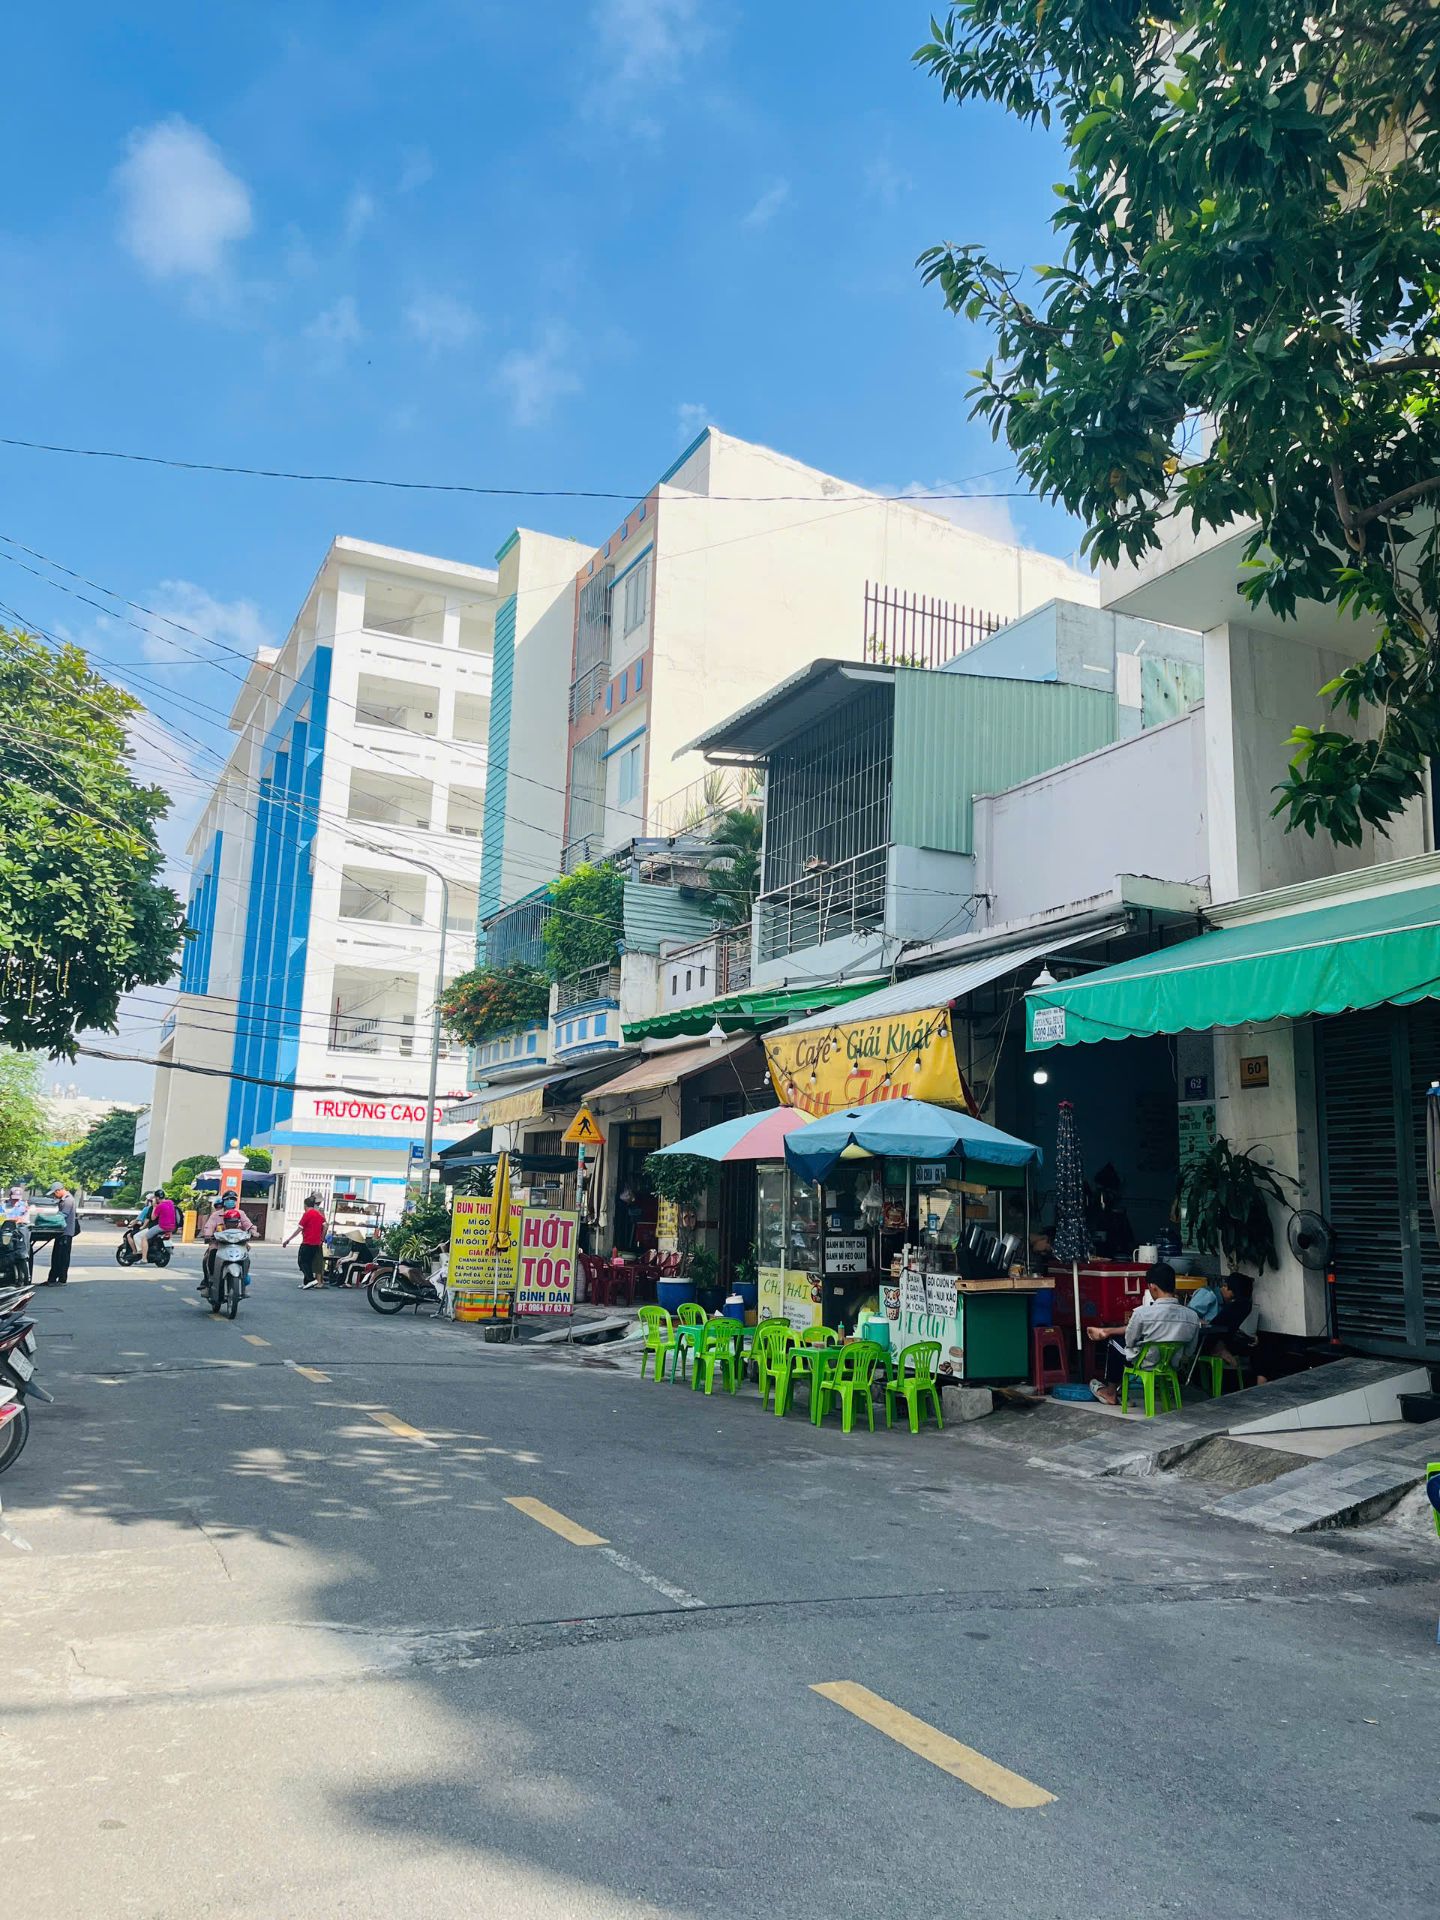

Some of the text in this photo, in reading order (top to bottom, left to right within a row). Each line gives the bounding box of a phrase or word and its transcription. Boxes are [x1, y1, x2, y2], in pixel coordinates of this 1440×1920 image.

[846, 1025, 881, 1060] Giải
[887, 1019, 932, 1055] Khát
[1247, 1062, 1261, 1075] 60
[1190, 1078, 1202, 1089] 62
[313, 1099, 386, 1119] TRƯỜNG
[391, 1106, 427, 1122] CAO
[476, 1203, 492, 1217] THỊT
[523, 1214, 574, 1249] HỚT
[521, 1252, 571, 1289] TÓC
[836, 1264, 856, 1272] 15K
[519, 1289, 571, 1302] BÌNH DÂN
[786, 1283, 810, 1300] HAI
